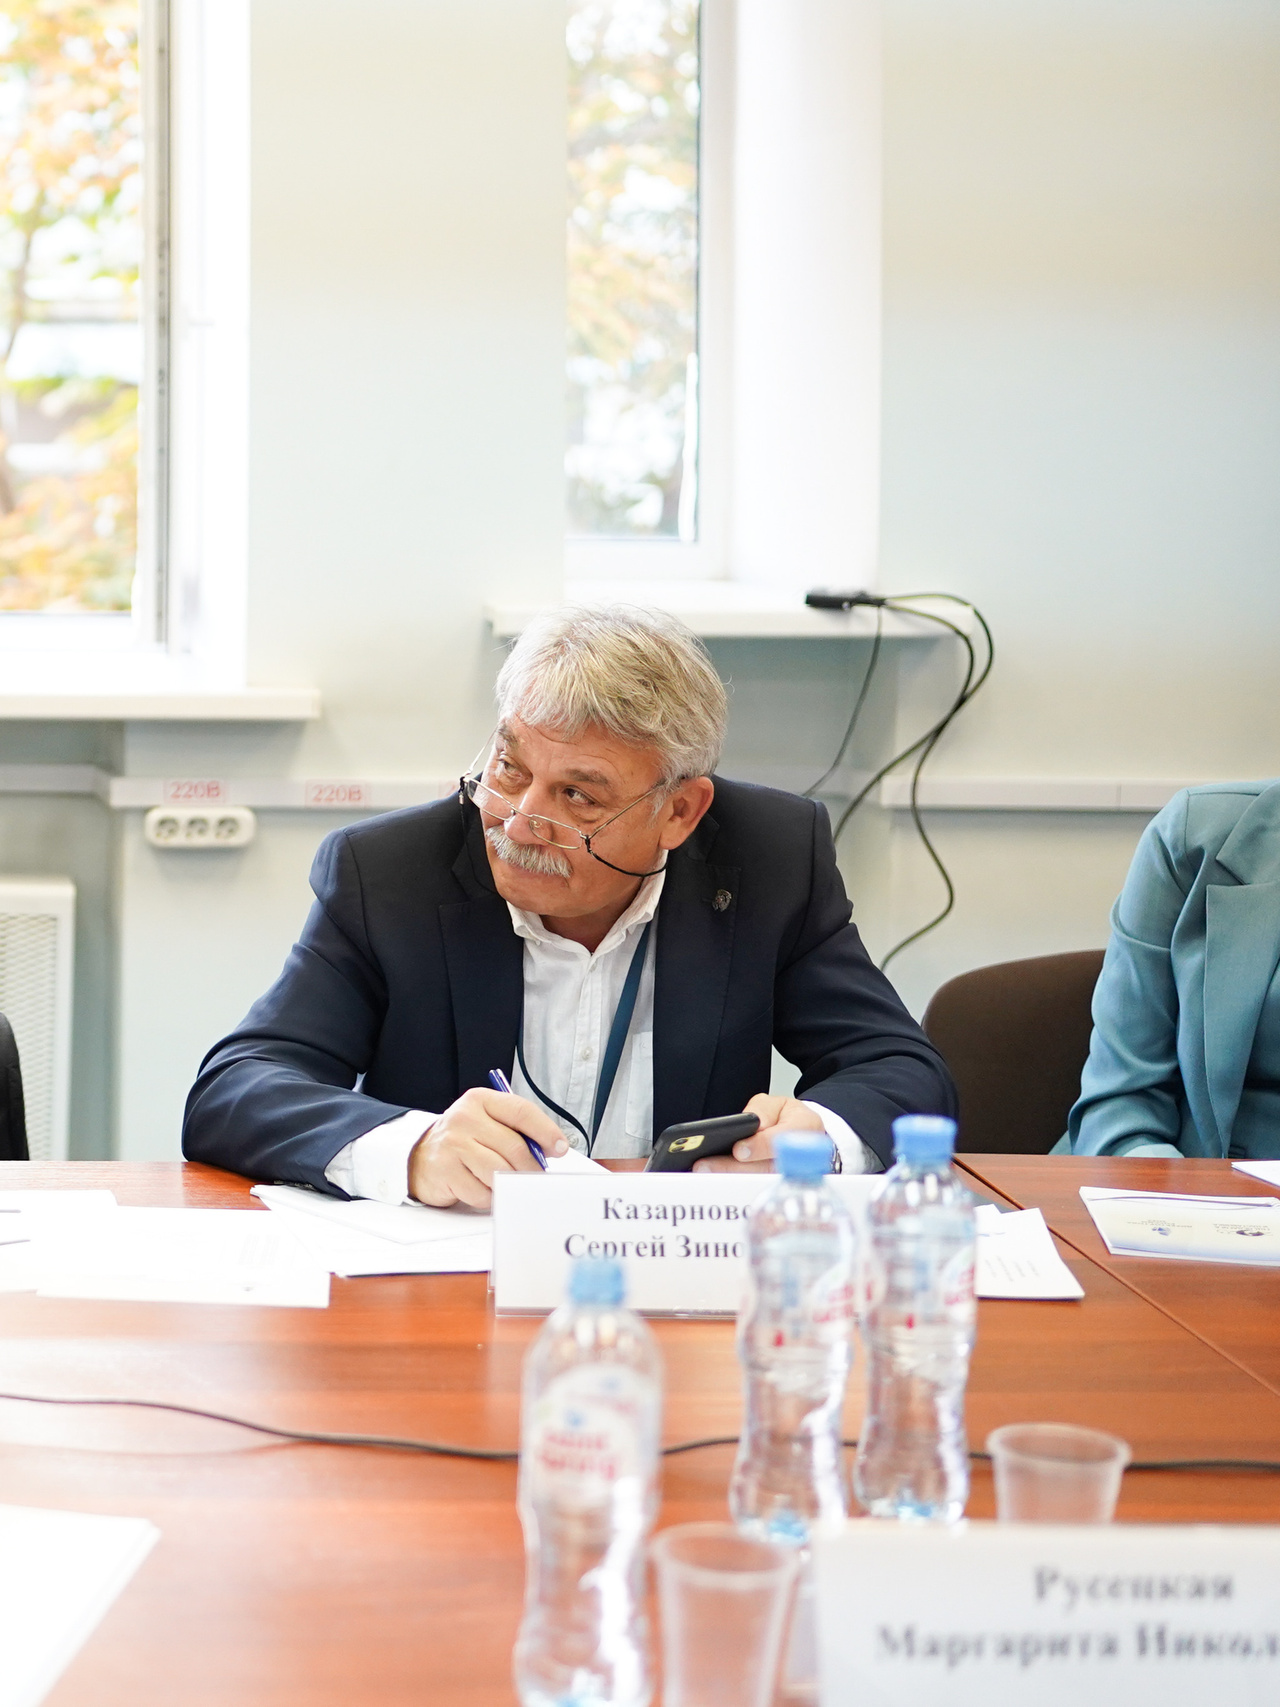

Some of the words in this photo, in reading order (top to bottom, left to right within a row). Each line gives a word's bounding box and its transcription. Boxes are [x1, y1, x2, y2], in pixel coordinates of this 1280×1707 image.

[170, 781, 222, 799] 220В
[311, 784, 363, 802] 220В
[563, 1233, 667, 1260] Сергей
[1033, 1565, 1235, 1611] Русецкая
[878, 1622, 1120, 1671] Маргарита
